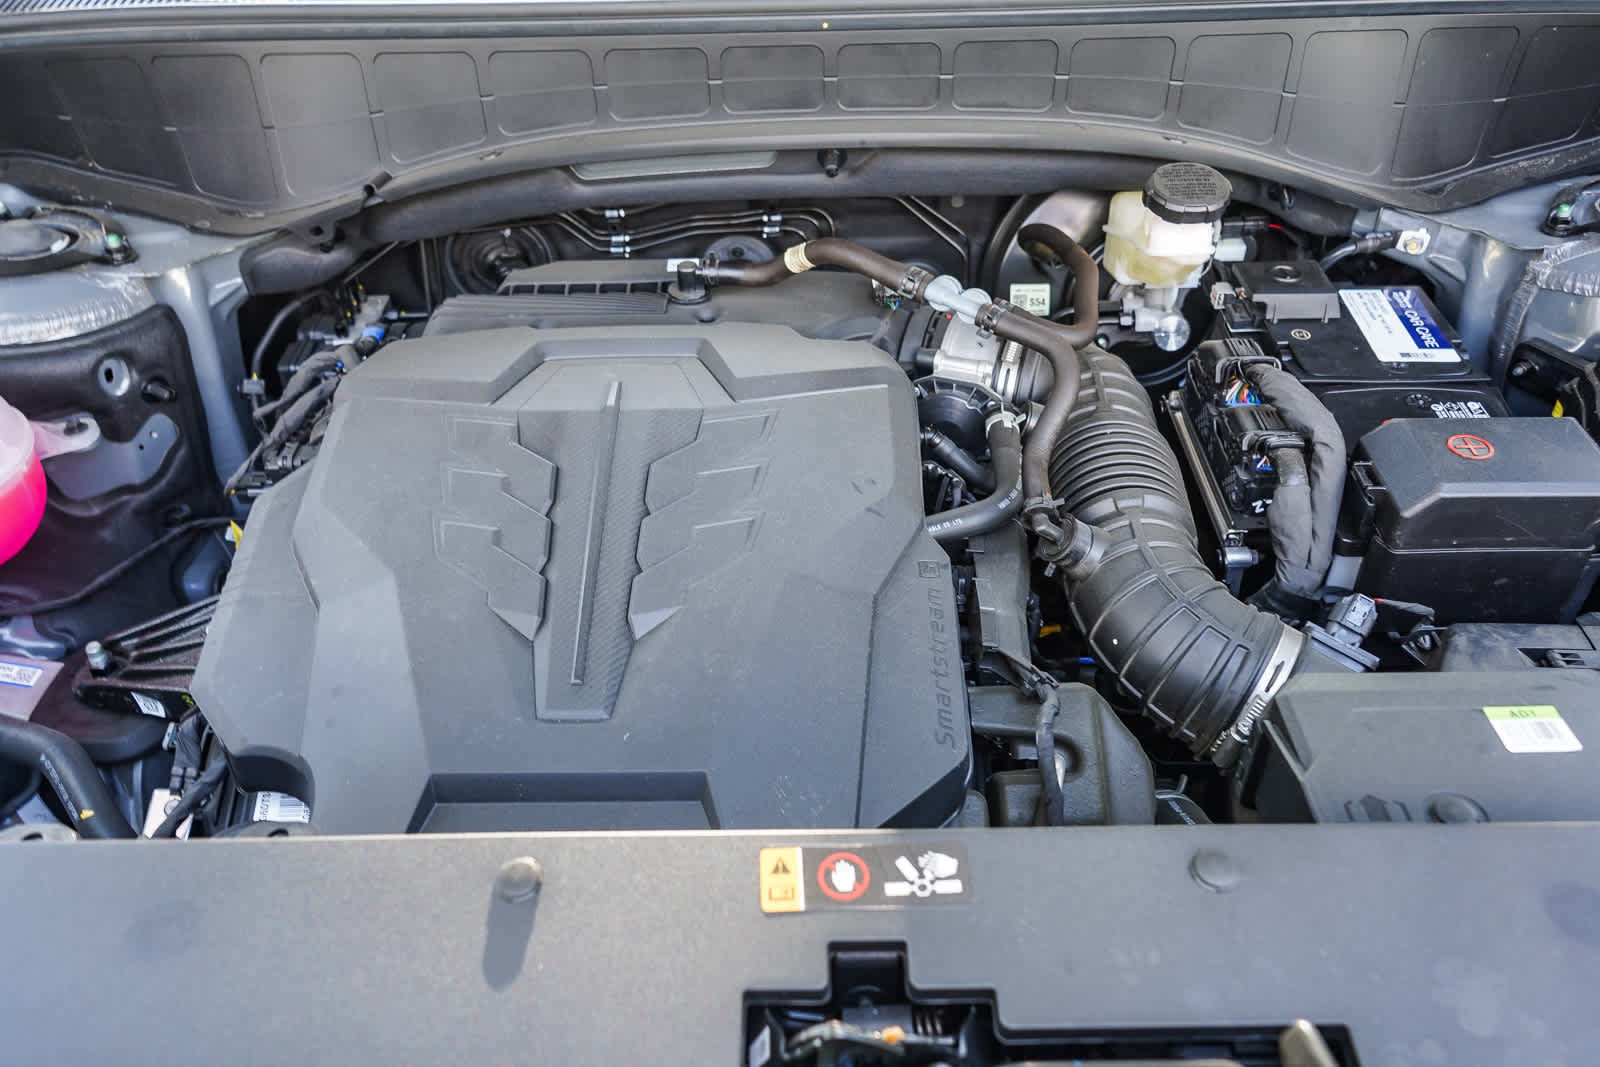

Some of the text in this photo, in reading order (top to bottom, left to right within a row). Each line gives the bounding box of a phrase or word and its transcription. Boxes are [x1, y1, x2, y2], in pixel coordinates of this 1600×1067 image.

[1405, 310, 1440, 348] CAR CARE
[928, 588, 956, 751] Smartstream
